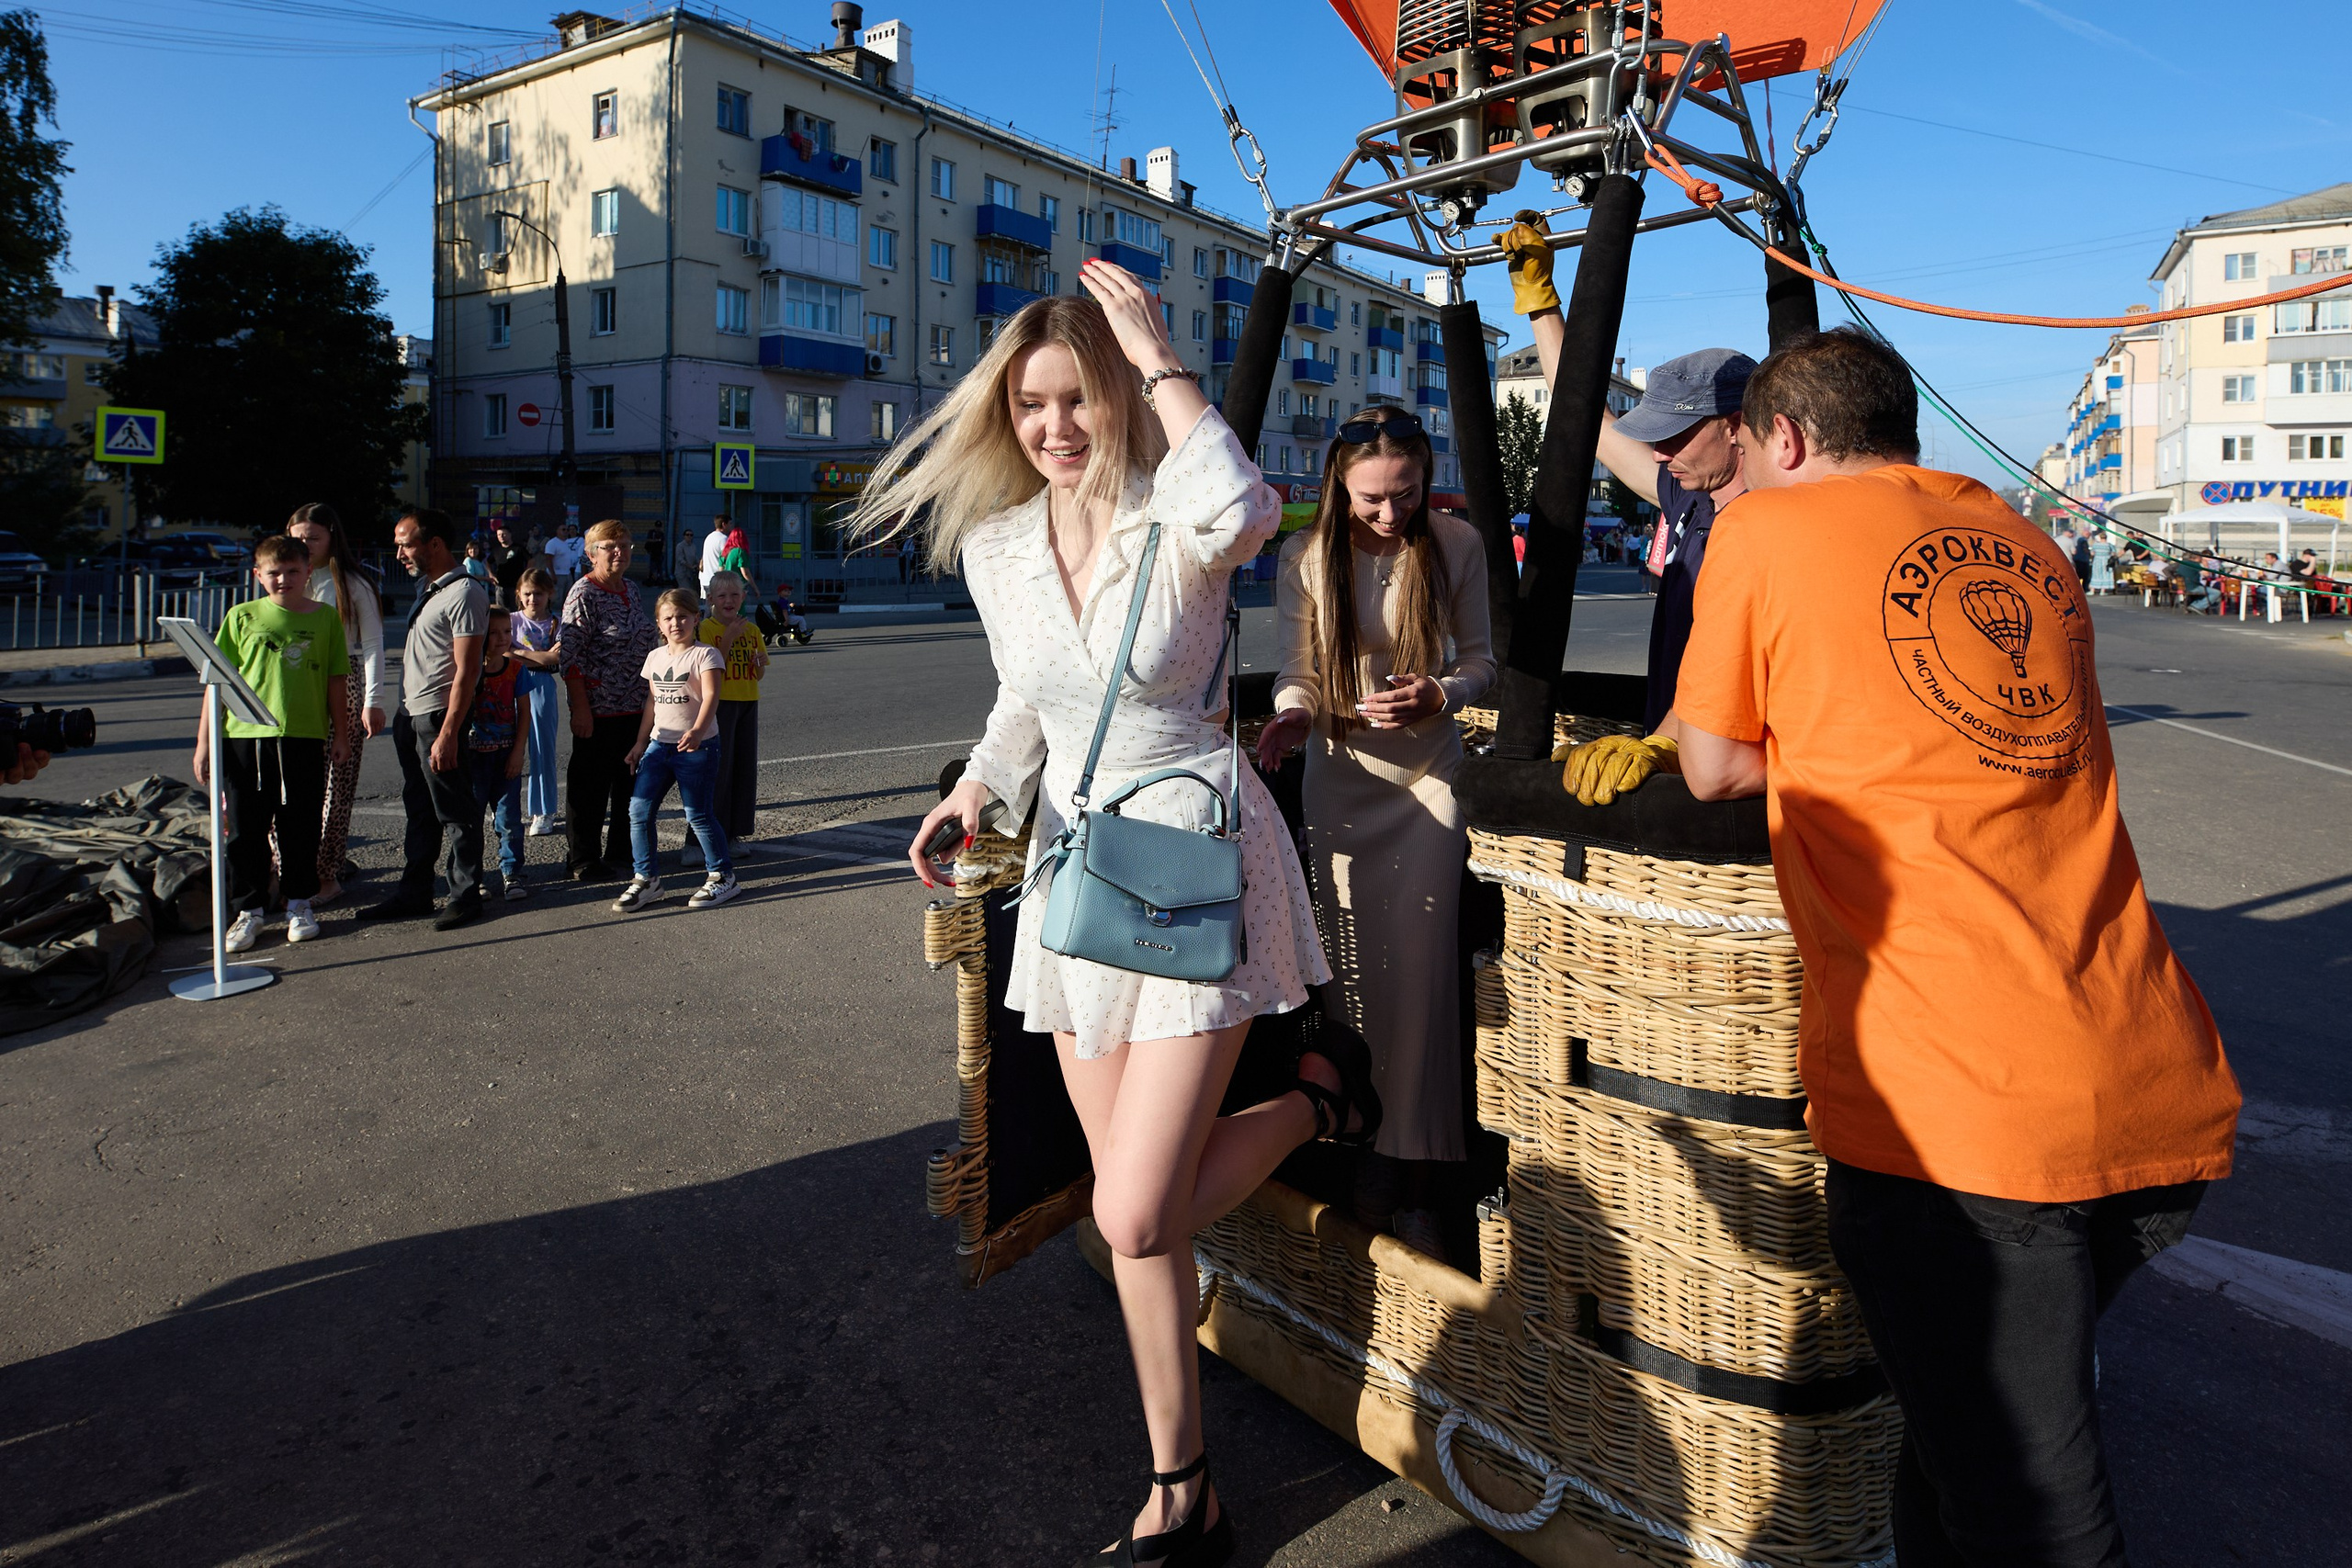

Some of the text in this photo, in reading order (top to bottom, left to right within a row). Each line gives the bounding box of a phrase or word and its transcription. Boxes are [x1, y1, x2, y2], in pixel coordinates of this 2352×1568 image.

[843, 472, 899, 484] АПТА
[2228, 480, 2352, 497] ПУТНИ
[1891, 536, 2081, 619] АЭРОКВЕСТ
[724, 662, 757, 681] LOOK
[1912, 649, 1962, 715] ЧАСТНЫЙ
[1997, 683, 2055, 707] ЧВК
[1978, 750, 2092, 782] www.aeroquest.ru
